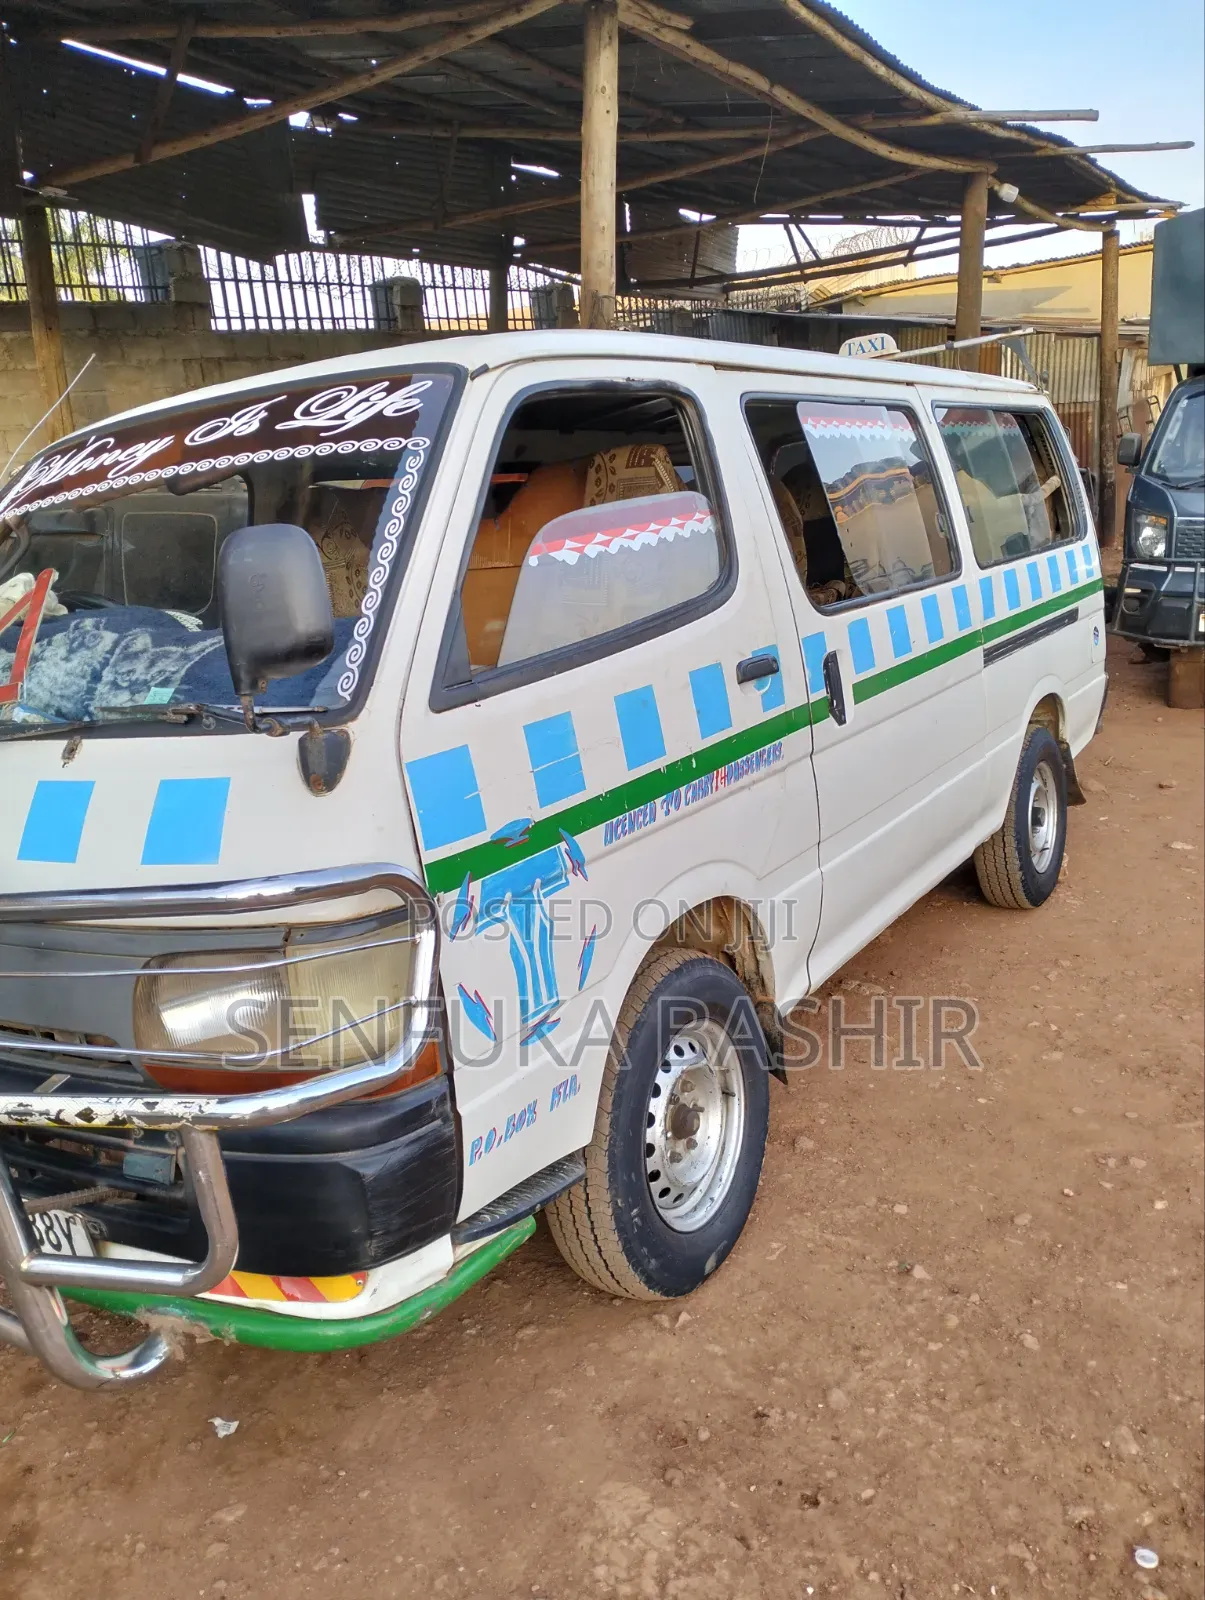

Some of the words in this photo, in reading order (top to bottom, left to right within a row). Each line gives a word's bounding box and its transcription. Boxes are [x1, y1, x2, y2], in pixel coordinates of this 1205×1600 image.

[844, 336, 886, 356] TAXI
[184, 395, 287, 446] Is
[276, 380, 433, 436] Life
[660, 788, 682, 817] TO
